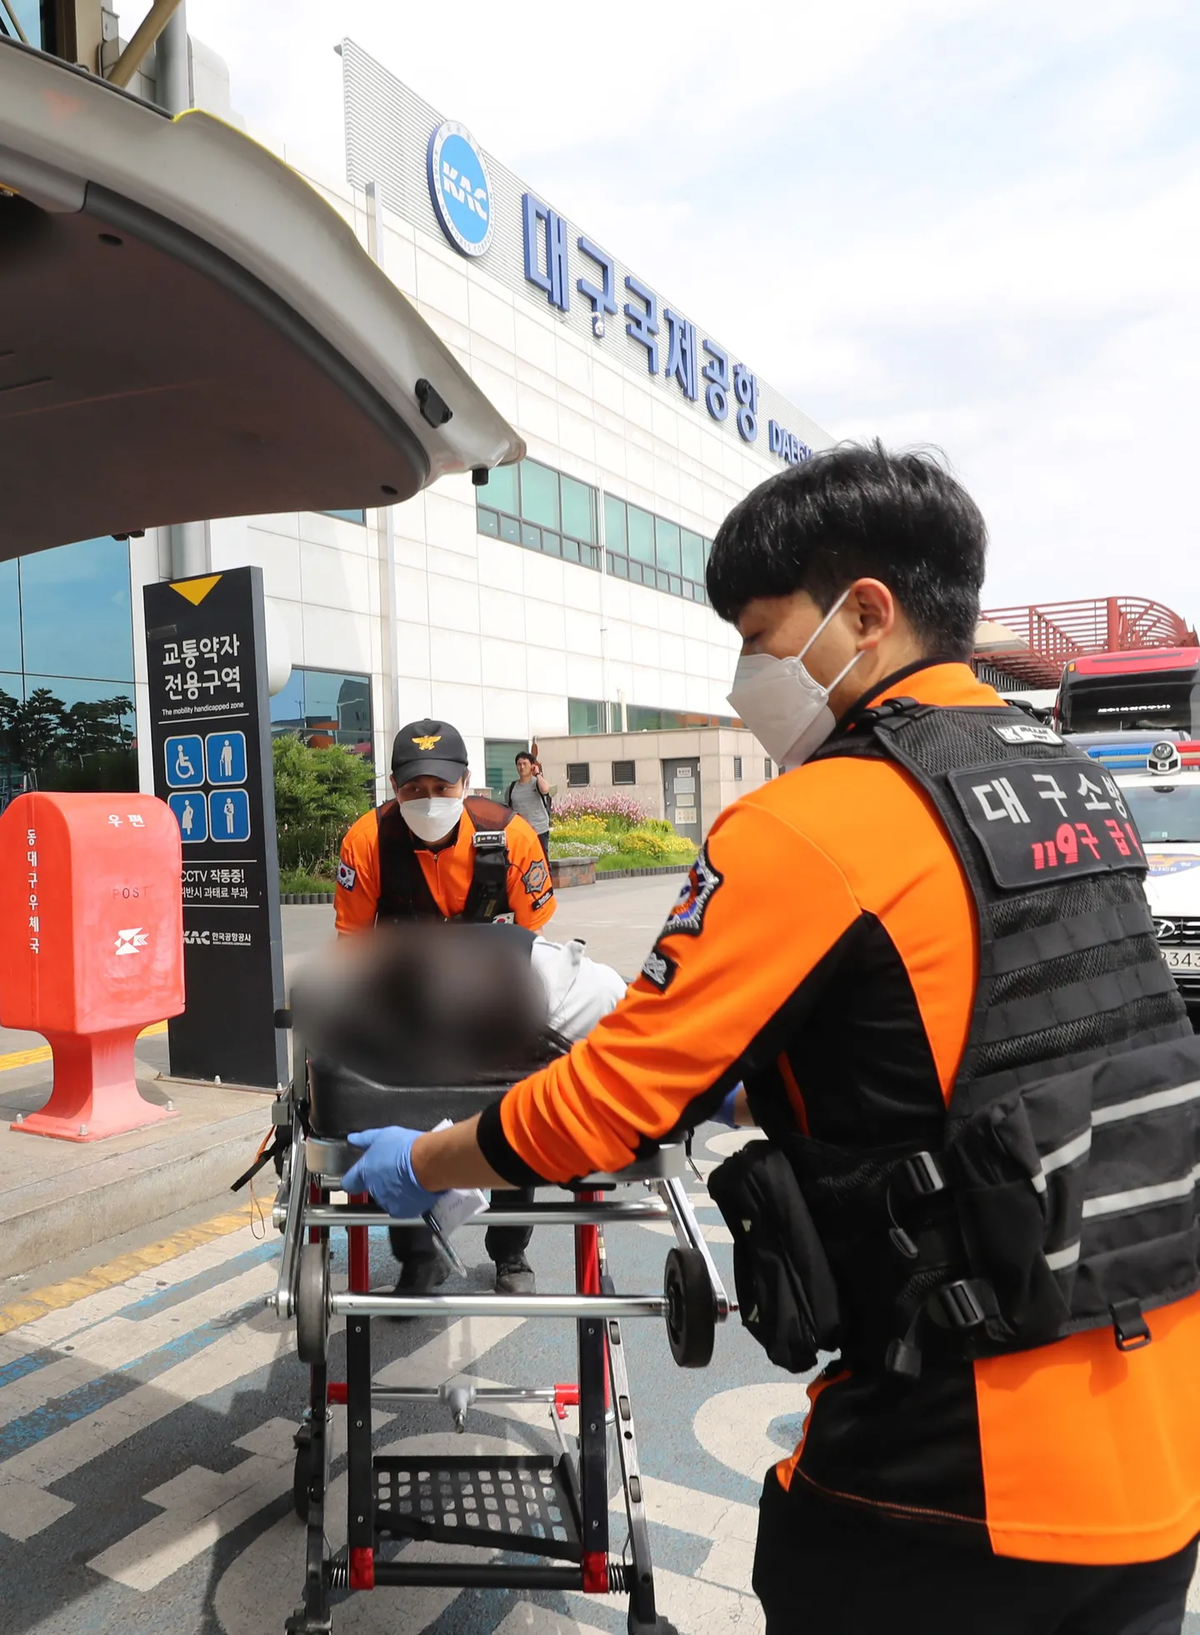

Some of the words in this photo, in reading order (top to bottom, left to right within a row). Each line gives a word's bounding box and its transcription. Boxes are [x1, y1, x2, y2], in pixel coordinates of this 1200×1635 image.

[442, 160, 488, 221] KAC
[522, 193, 760, 443] 대구국제공항
[162, 633, 240, 669] 교통약자
[164, 665, 241, 700] 전용구역
[162, 708, 173, 716] The
[173, 706, 194, 715] mobility
[193, 702, 230, 713] handicapped
[230, 701, 244, 709] zone
[180, 870, 208, 882] CCTV
[209, 869, 245, 884] 작동중!
[203, 886, 230, 899] 과태료
[230, 886, 249, 899] 부과
[211, 931, 252, 942] 한국공항공사
